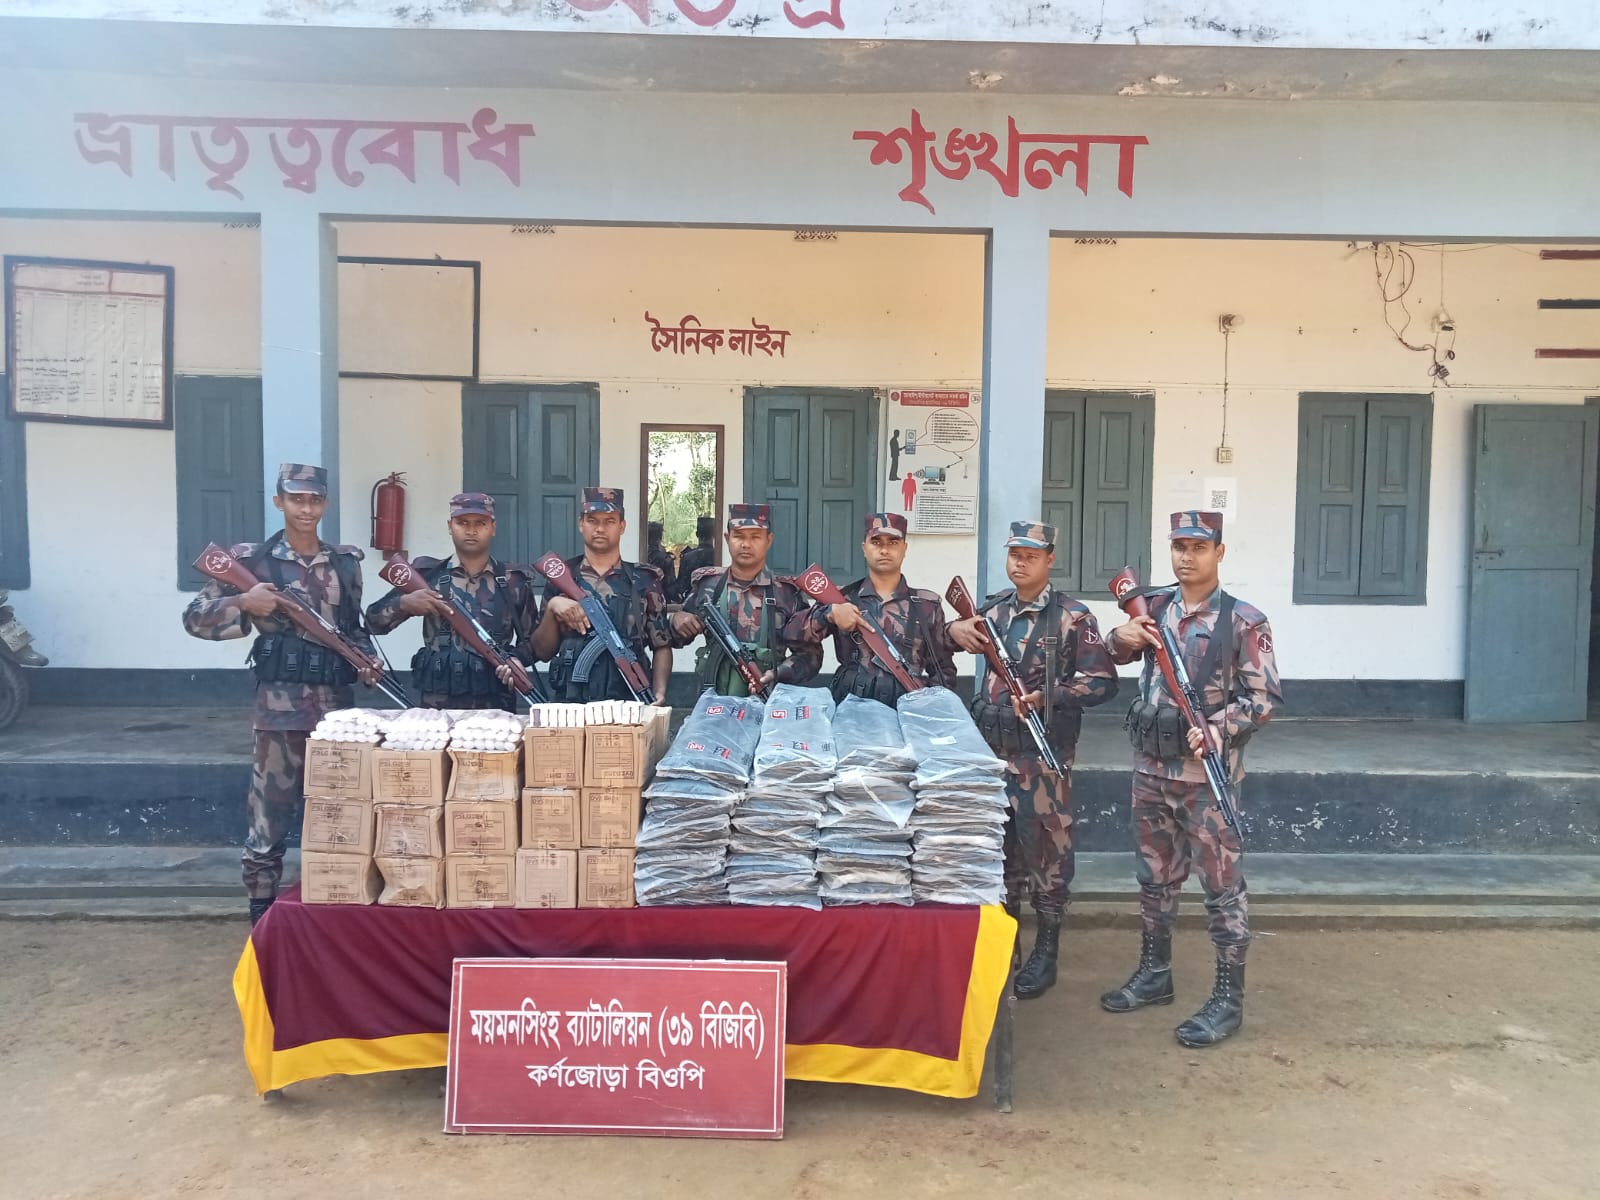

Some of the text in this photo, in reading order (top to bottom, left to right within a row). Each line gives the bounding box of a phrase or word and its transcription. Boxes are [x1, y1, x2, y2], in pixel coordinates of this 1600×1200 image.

[73, 107, 536, 200] ভ্রাতৃত্ববোধ
[853, 108, 1149, 215] শৃঙ্খলা
[644, 310, 792, 358] সৈনিক লাইন
[469, 997, 766, 1060] ময়মনসিংহ ব্যাটালিয়ন (৩৯ বিজিবি)
[525, 1056, 706, 1093] কর্ণজোড়া বিওপি
